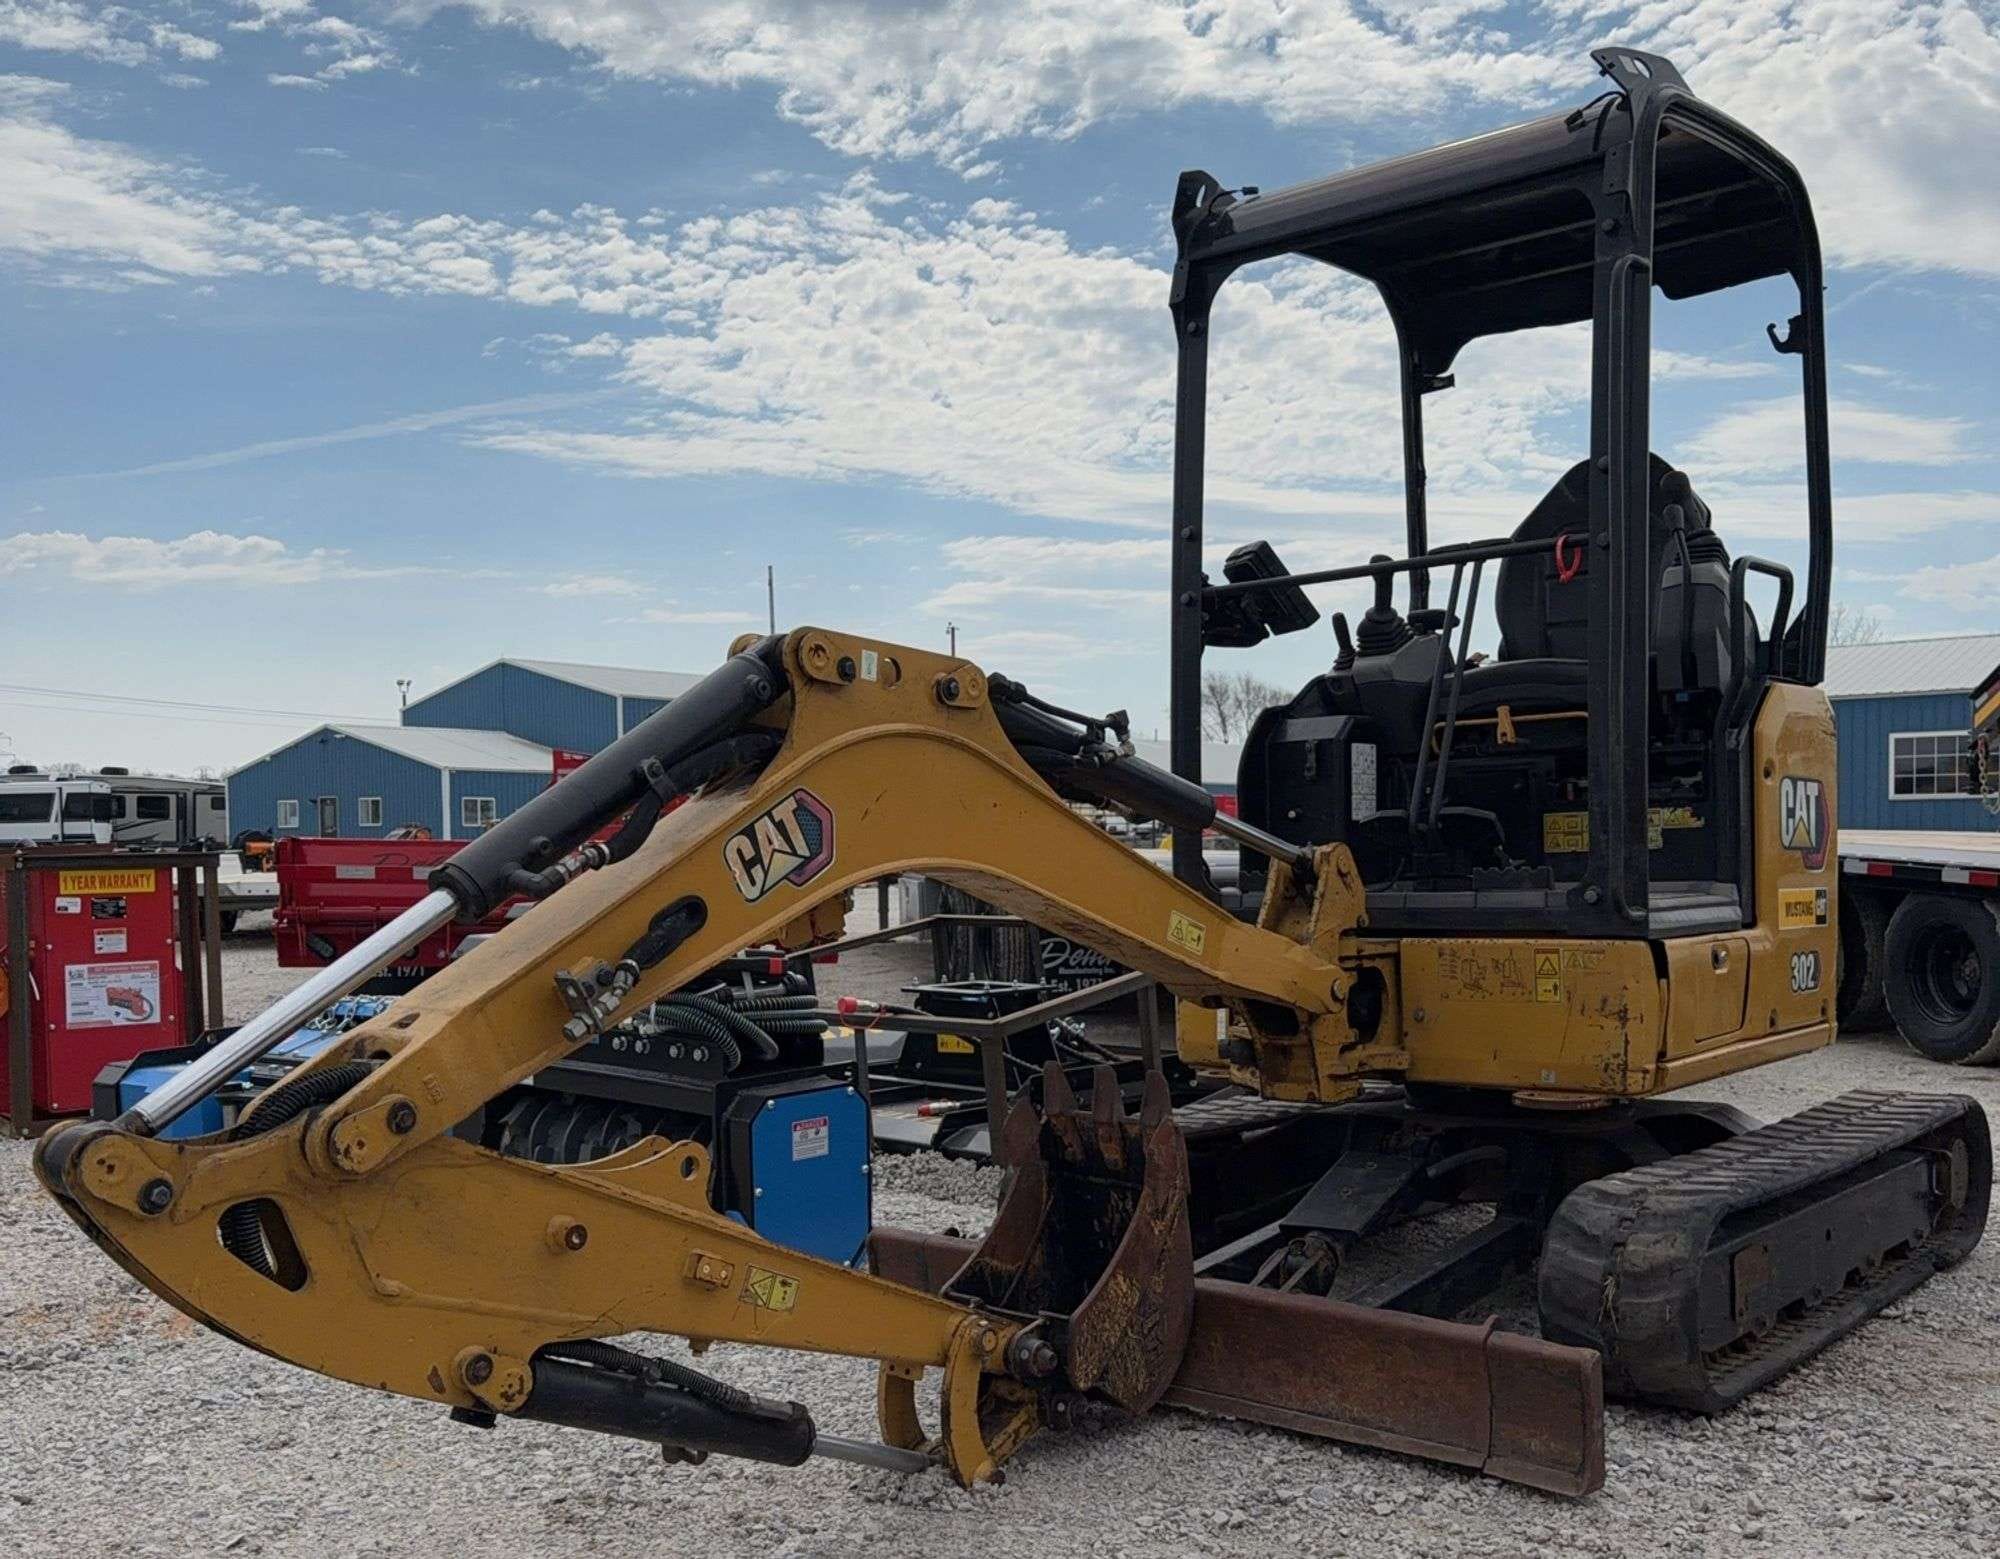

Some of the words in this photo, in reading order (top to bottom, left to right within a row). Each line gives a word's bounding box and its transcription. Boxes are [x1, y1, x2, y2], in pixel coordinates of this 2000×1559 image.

[1780, 778, 1819, 848] CAT
[725, 795, 811, 899] CAT
[70, 876, 97, 890] YEAR
[98, 874, 152, 889] WARRANTY
[1791, 953, 1815, 991] 302
